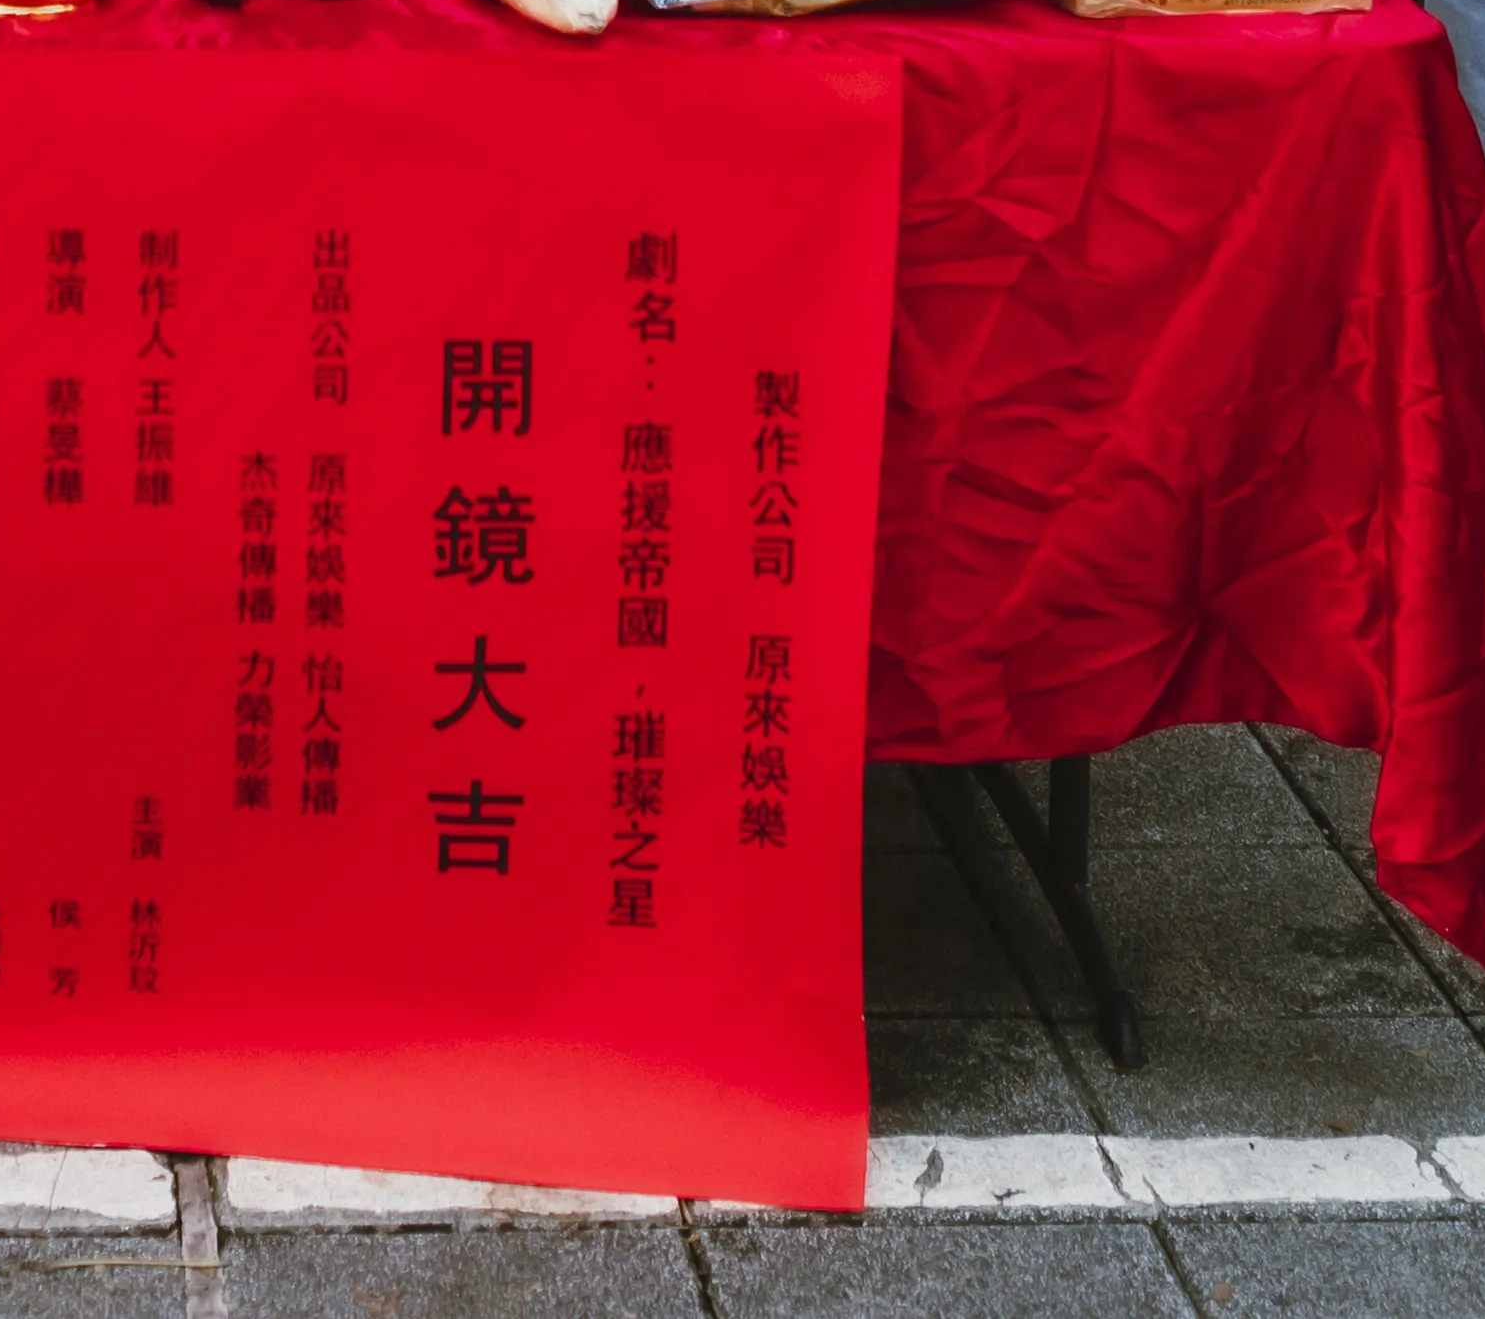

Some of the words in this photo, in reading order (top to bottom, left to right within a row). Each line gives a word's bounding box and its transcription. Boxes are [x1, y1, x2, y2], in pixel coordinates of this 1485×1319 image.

[47, 228, 86, 314] 導演
[137, 229, 179, 359] 制作人
[310, 228, 351, 406] 出品公司
[306, 453, 346, 628] 原來娛樂
[749, 370, 801, 585] 製作公司
[427, 339, 535, 876] 開鏡大吉
[300, 654, 343, 815] 怡人傳播
[739, 635, 792, 848] 原來娛樂
[131, 794, 164, 860] 主演
